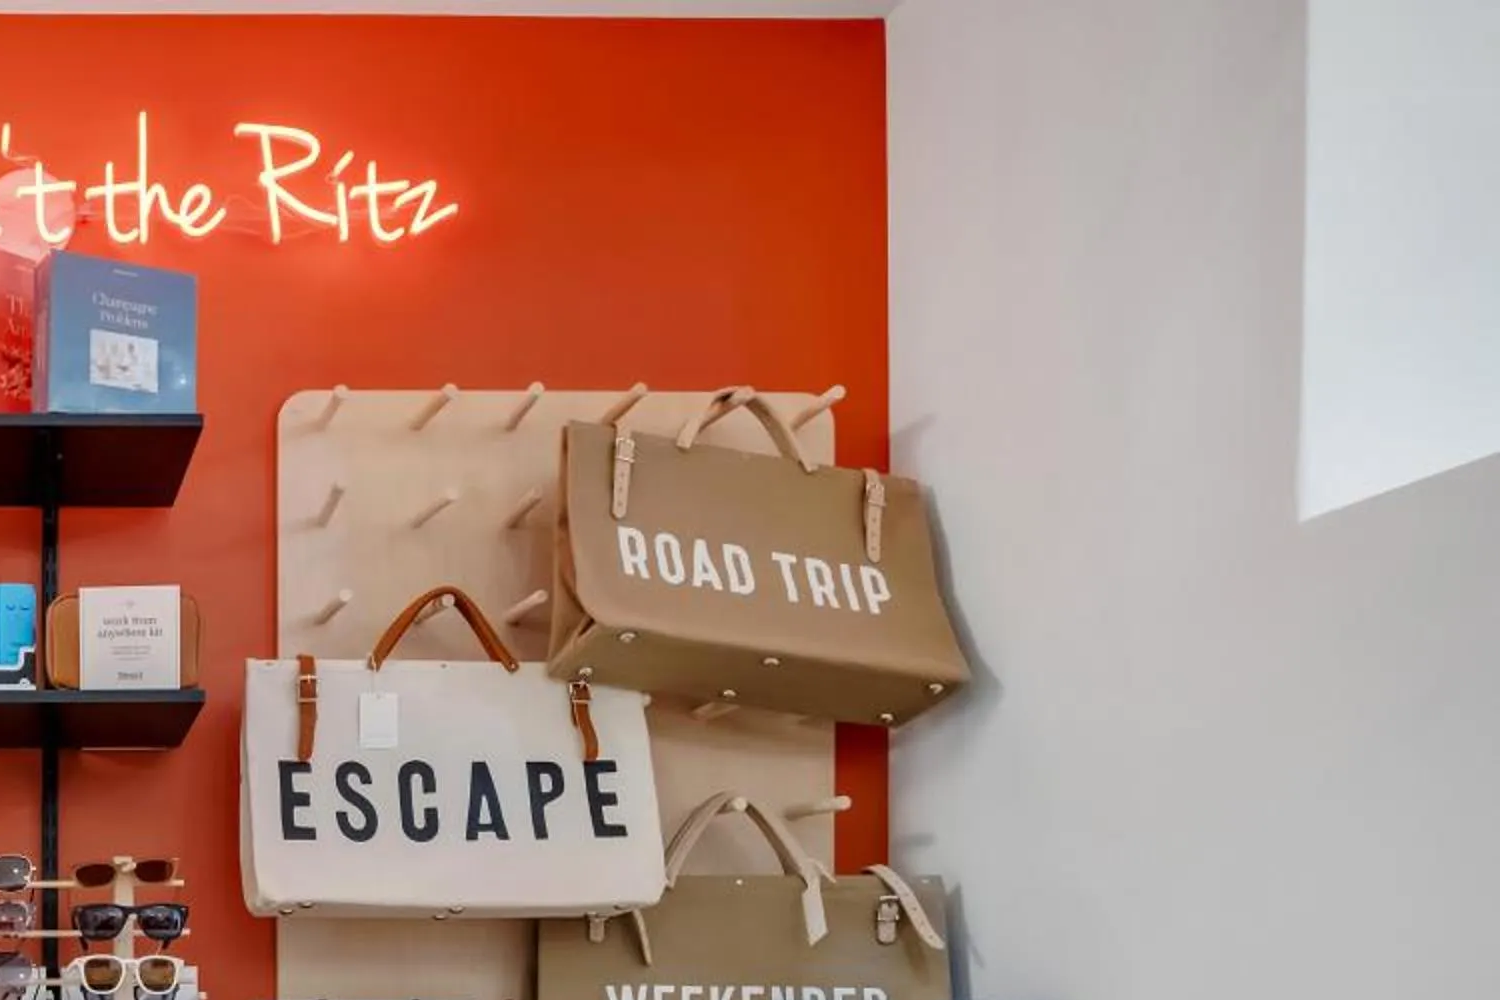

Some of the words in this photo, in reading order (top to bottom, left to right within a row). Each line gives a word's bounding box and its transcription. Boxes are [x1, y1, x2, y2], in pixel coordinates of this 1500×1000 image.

[85, 110, 227, 246] the
[234, 121, 460, 245] Ritz
[617, 525, 756, 596] ROAD
[771, 551, 892, 614] TRIP
[277, 759, 629, 843] ESCAPE
